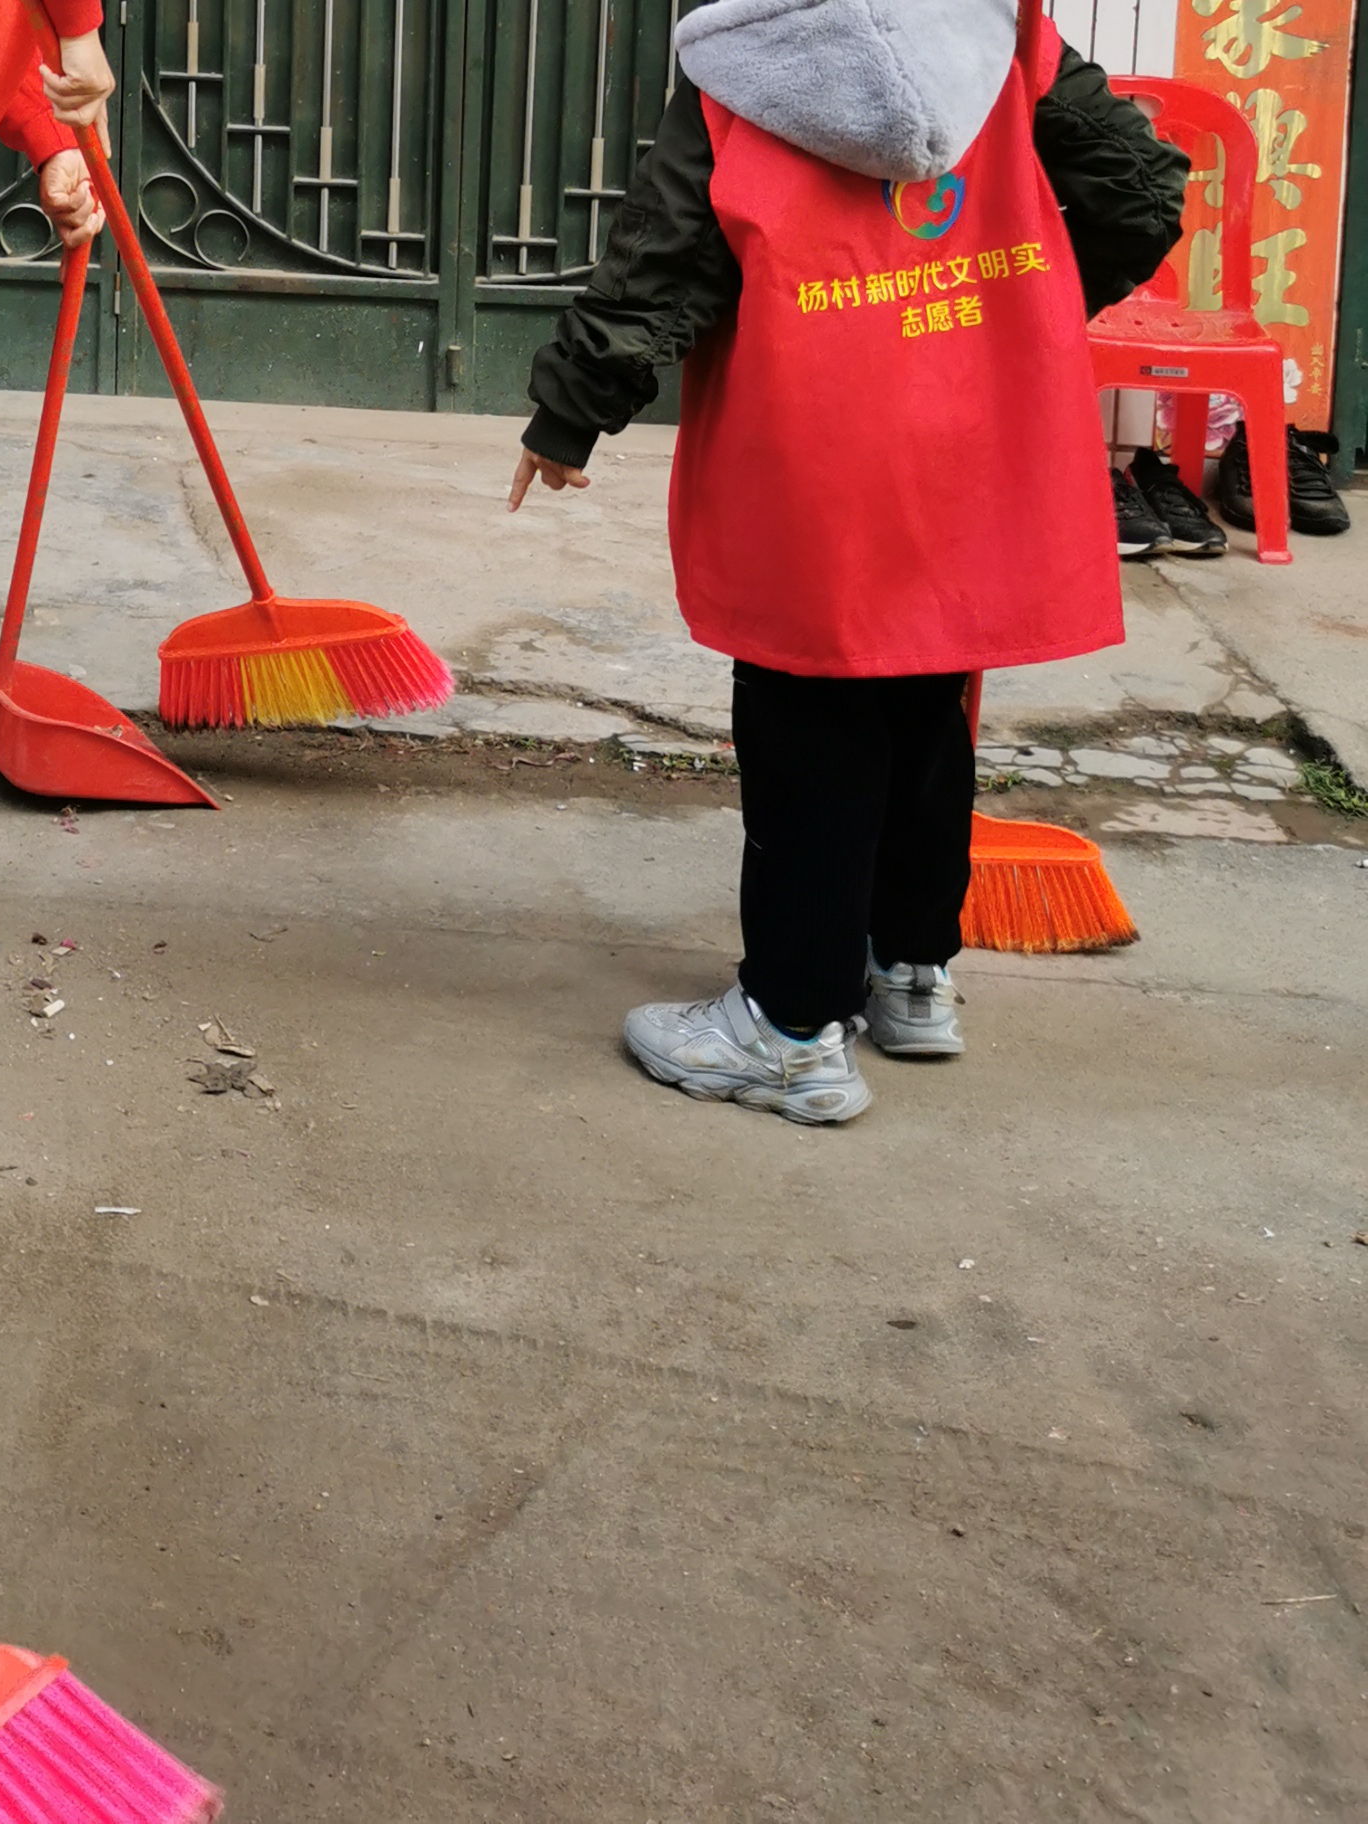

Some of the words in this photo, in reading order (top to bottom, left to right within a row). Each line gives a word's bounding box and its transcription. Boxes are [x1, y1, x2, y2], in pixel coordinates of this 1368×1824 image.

[797, 242, 1051, 314] 杨村新时代文明实
[901, 295, 983, 338] 志愿者
